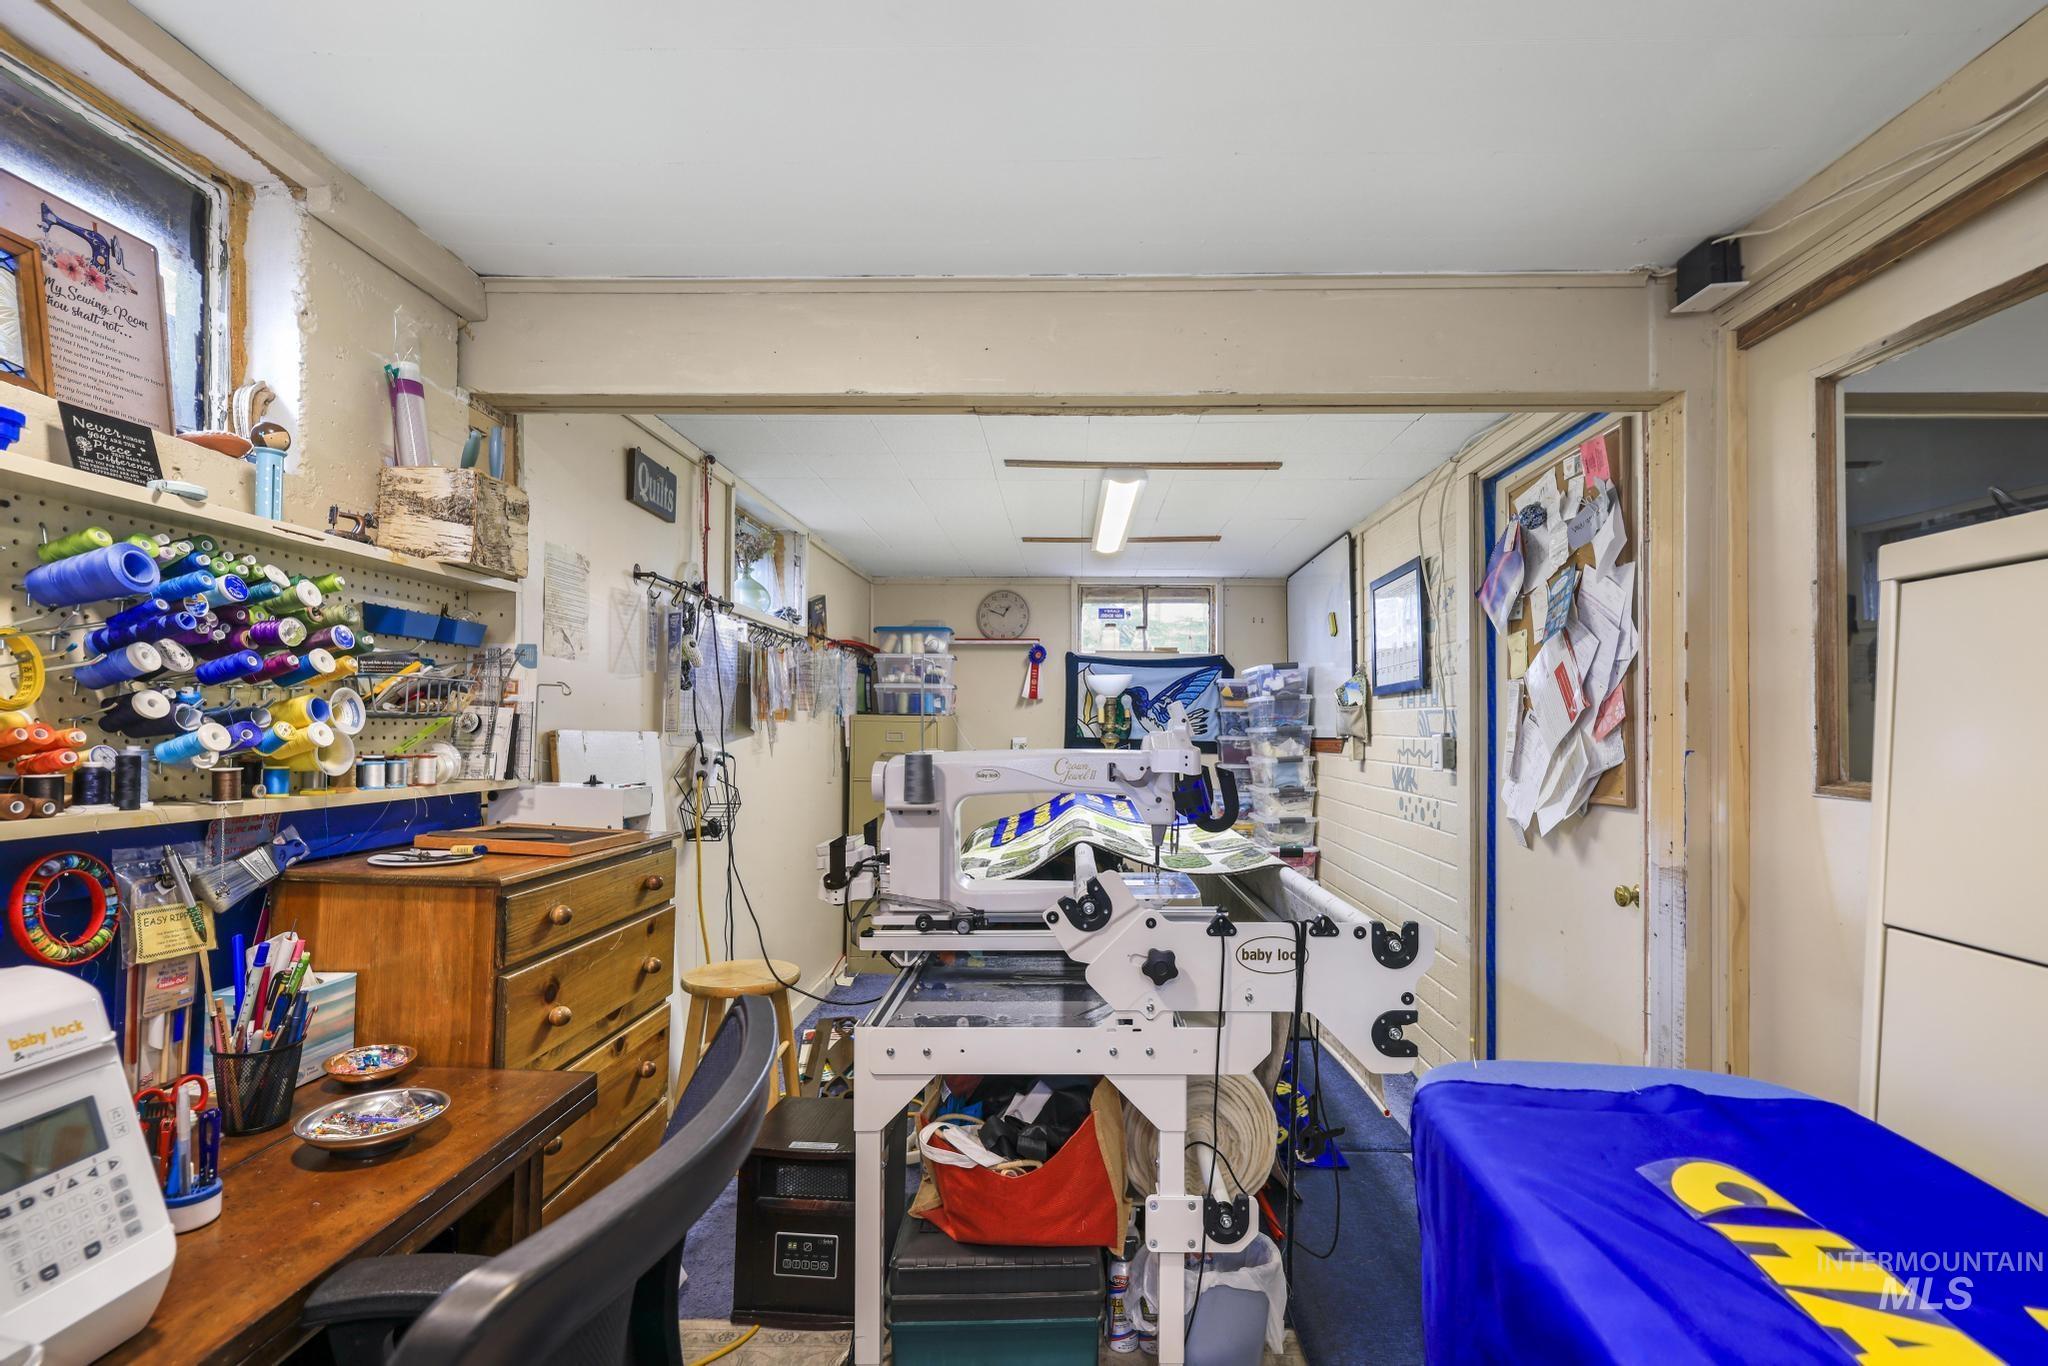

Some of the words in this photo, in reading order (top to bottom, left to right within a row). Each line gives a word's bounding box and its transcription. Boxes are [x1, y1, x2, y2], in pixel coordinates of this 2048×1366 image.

[44, 276, 67, 299] My
[67, 285, 112, 316] Sewing
[113, 305, 150, 331] Room
[48, 324, 74, 337] nything
[72, 415, 121, 438] Never
[87, 430, 108, 441] you
[93, 439, 132, 457] Piece
[95, 451, 155, 474] Difference
[638, 462, 674, 513] Quilts
[1054, 757, 1090, 776] Crown
[143, 915, 168, 927] EASY
[169, 911, 190, 923] RIPP
[1242, 948, 1272, 964] baby
[1277, 948, 1297, 961] loc
[7, 1032, 47, 1052] baby
[51, 1019, 85, 1038] lock
